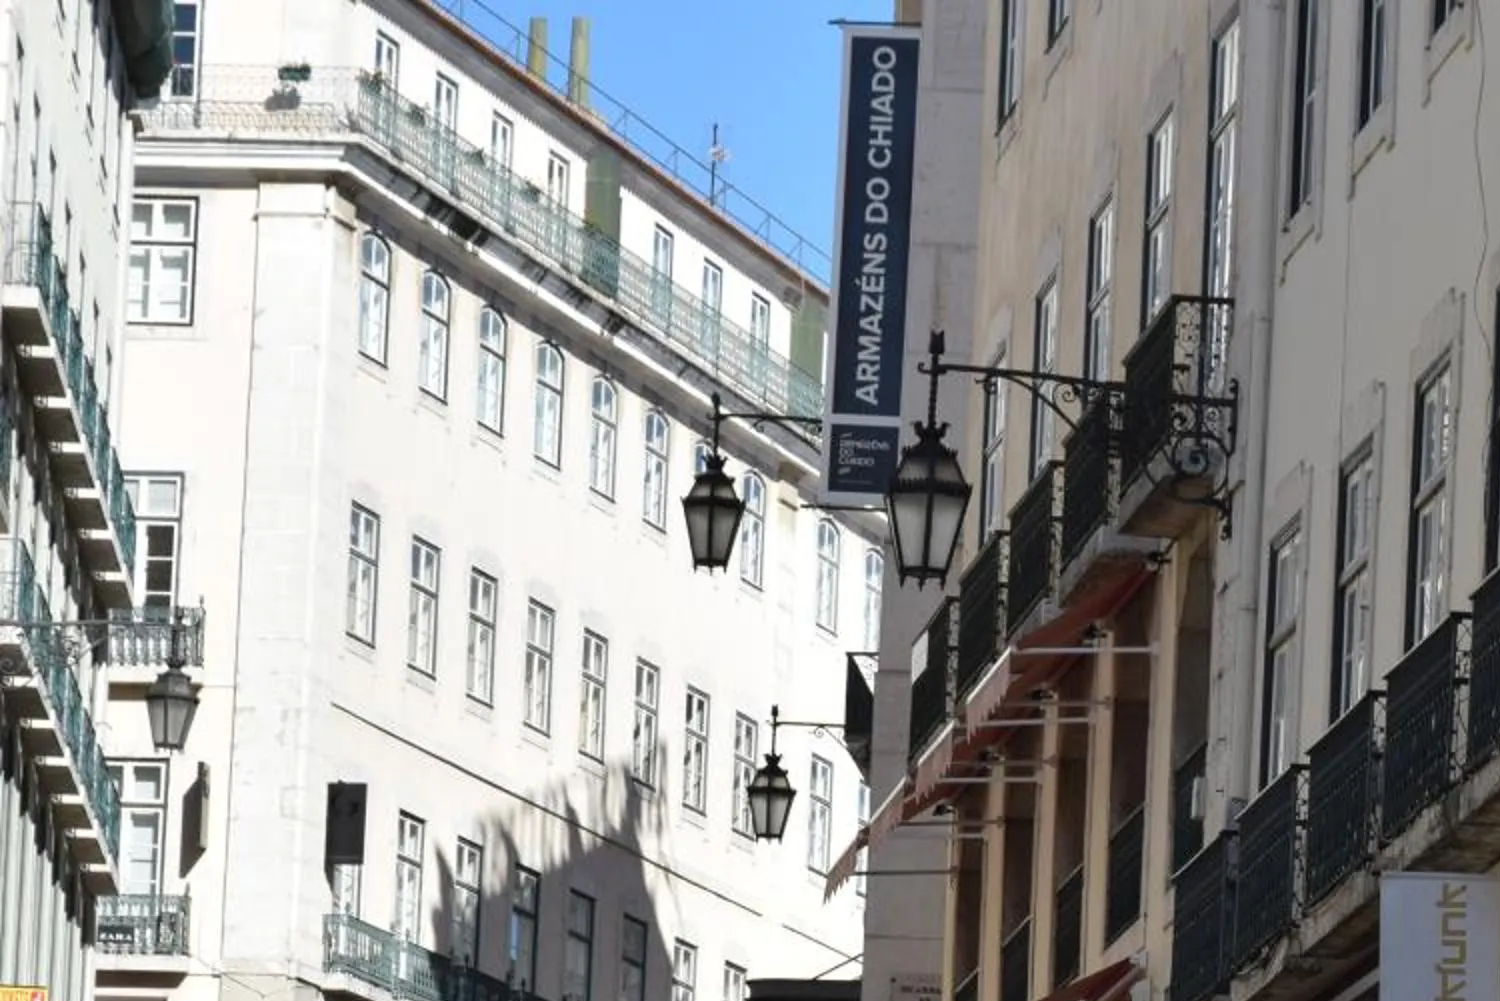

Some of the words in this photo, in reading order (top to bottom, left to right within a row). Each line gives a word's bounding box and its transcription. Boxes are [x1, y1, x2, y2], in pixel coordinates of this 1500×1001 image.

[867, 46, 897, 170] CHIADO
[864, 177, 891, 225] DO
[855, 232, 888, 405] ARMAZÉNS
